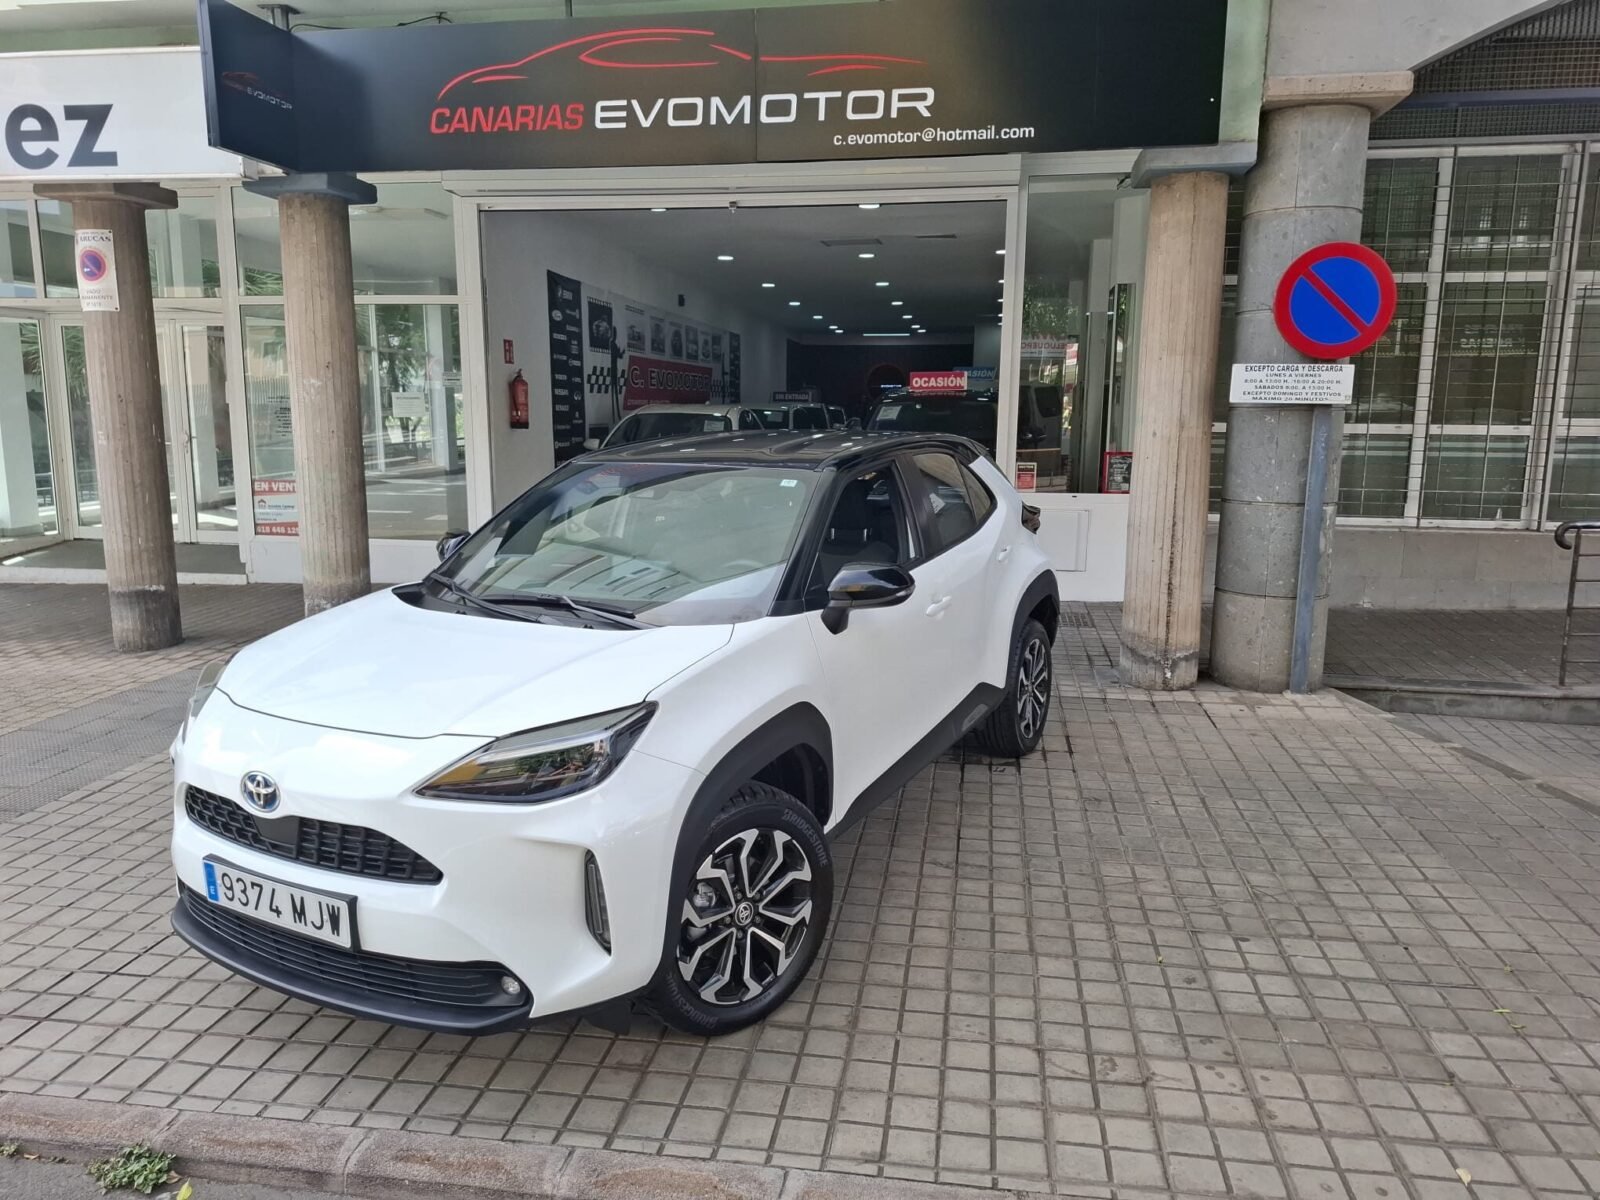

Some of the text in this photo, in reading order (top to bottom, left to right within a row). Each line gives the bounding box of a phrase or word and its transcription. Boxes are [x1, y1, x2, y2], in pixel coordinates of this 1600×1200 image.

[429, 86, 935, 135] CANARIAS EVOMOTOR
[4, 102, 119, 171] ez
[833, 124, 1036, 147] c.evomotor@hotmail.com
[912, 374, 965, 388] OCASIÓN
[1245, 365, 1275, 373] EXCEPTO
[1307, 365, 1344, 373] DESCARGA
[254, 481, 269, 492] EN
[781, 808, 829, 868] BRIDGESTONE
[221, 872, 341, 938] 9374 MJW
